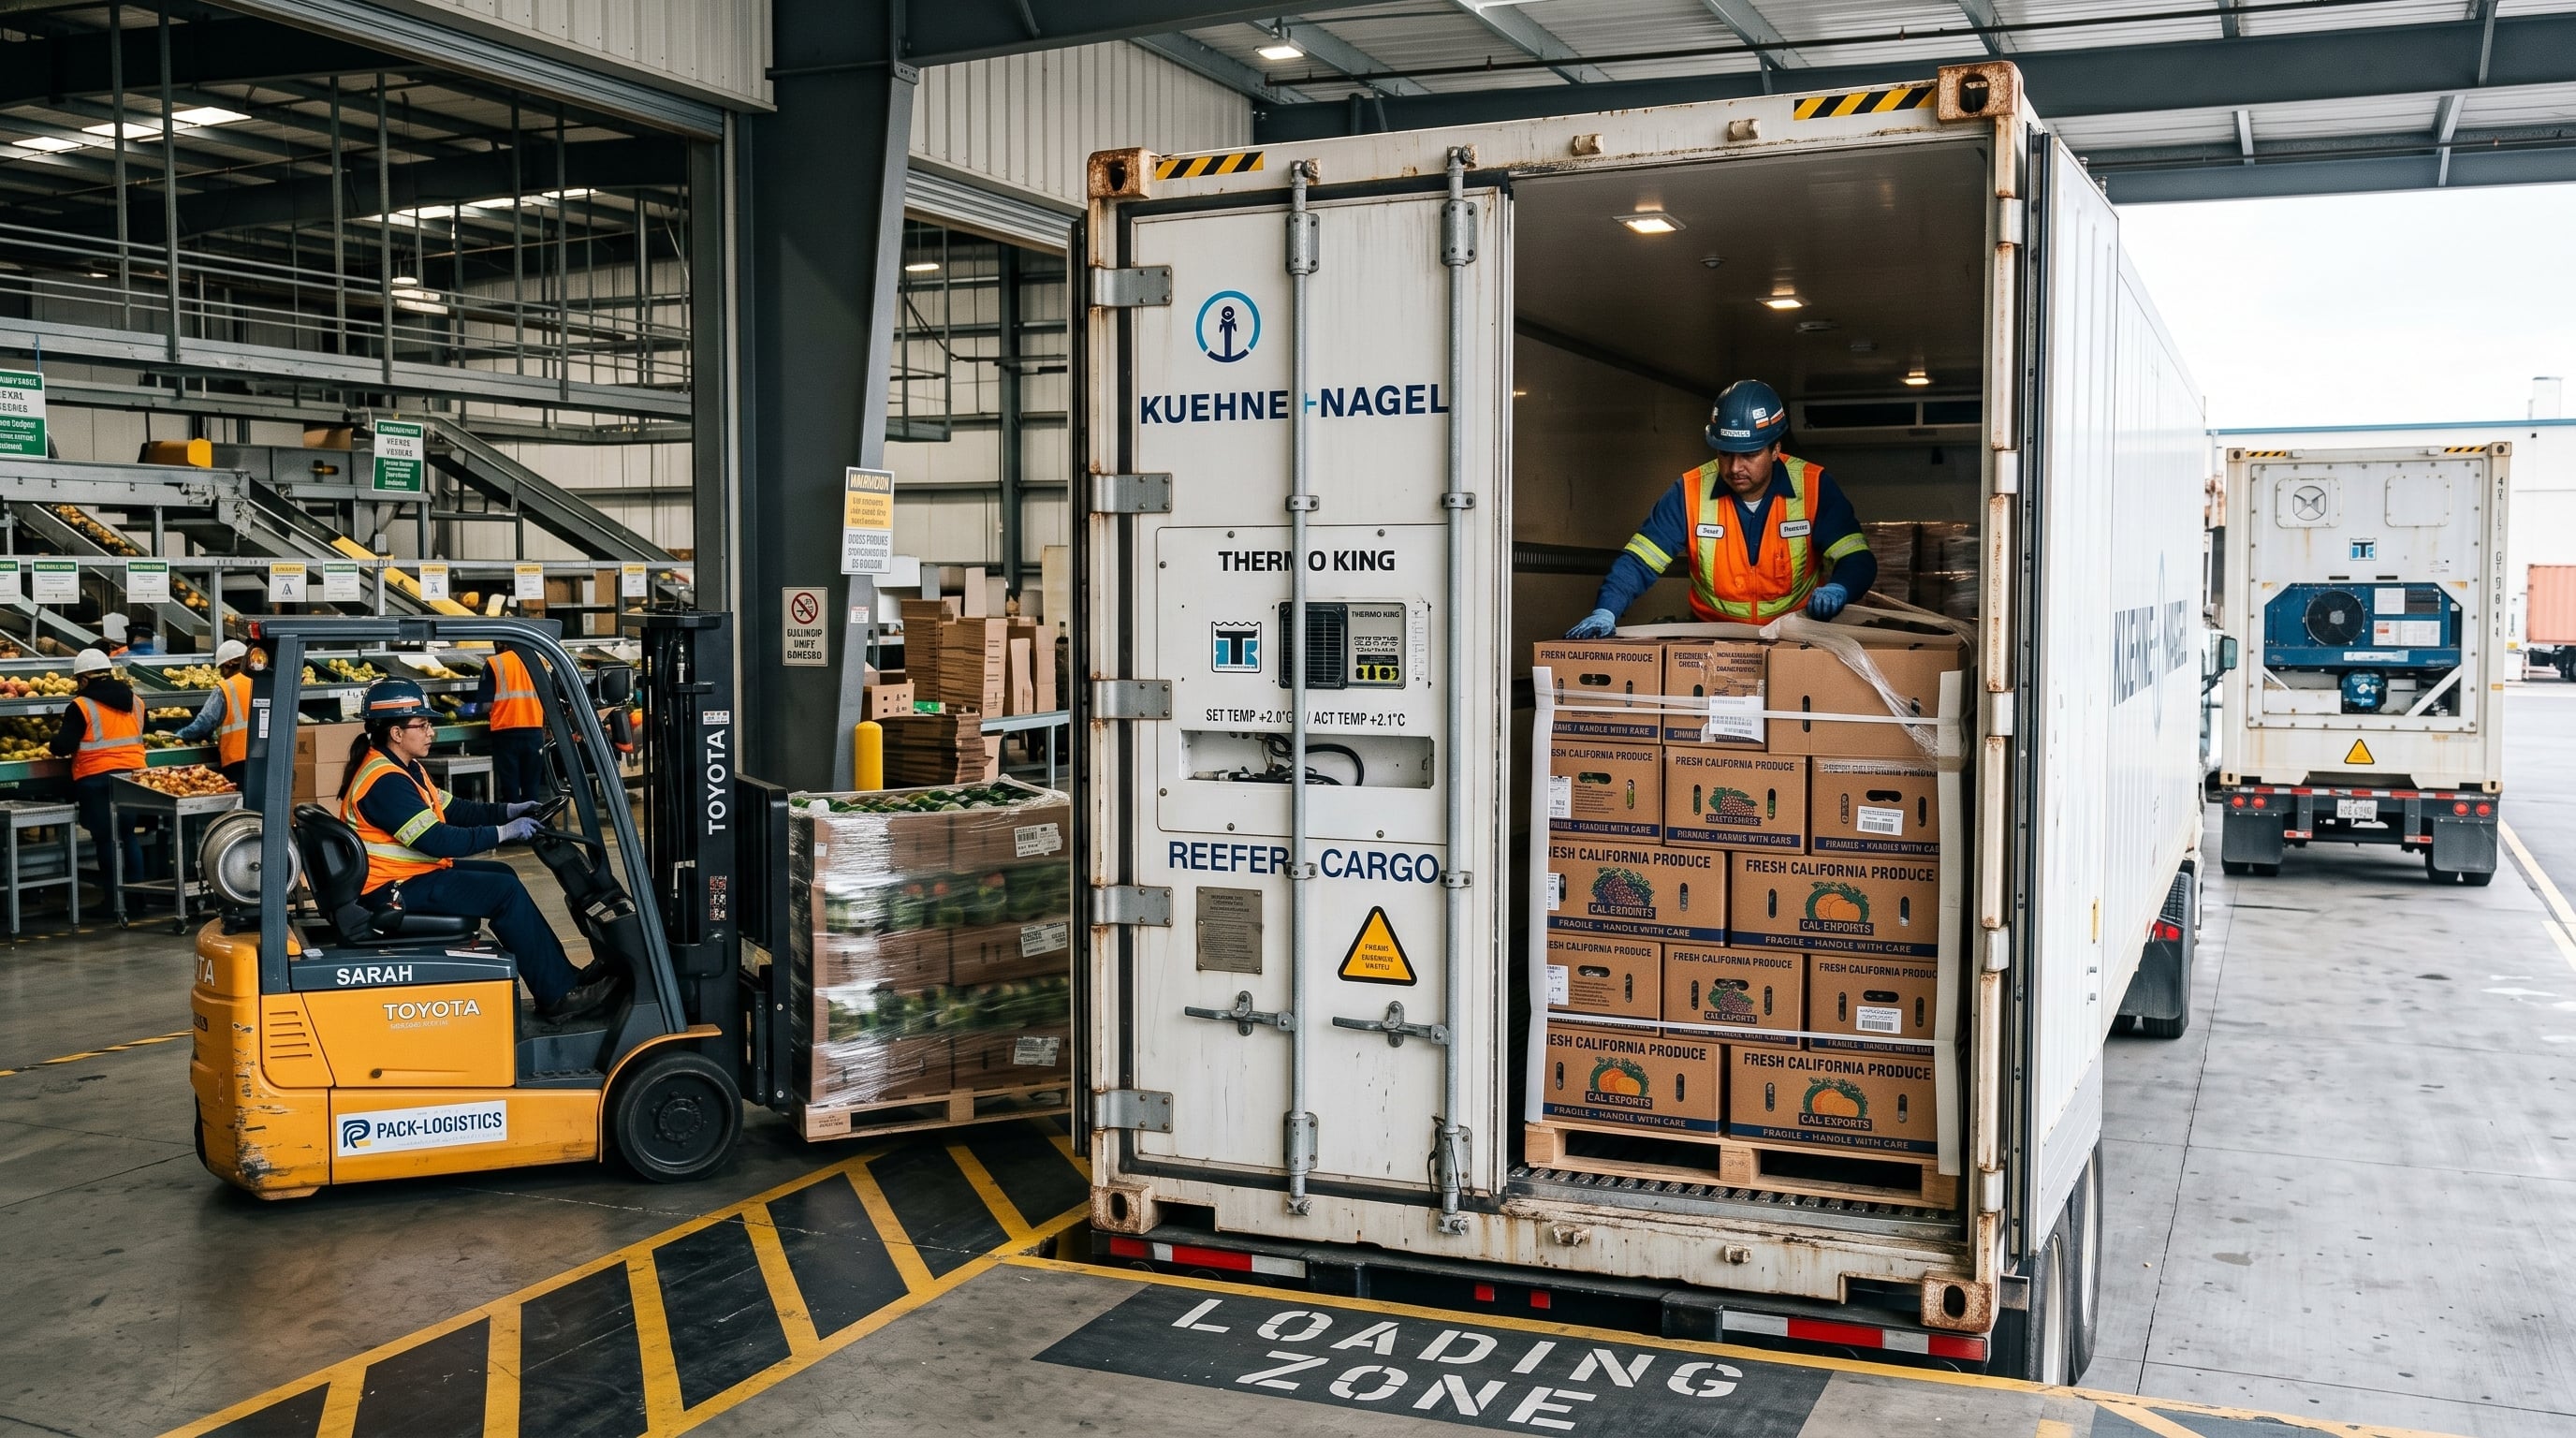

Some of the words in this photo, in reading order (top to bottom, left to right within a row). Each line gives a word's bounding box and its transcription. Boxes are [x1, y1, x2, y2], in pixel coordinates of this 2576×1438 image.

[1333, 550, 1395, 571] KING
[1568, 651, 1614, 661] CALIFORNIA
[1616, 653, 1653, 663] PRODUCE
[1207, 709, 1224, 721] SET
[1227, 709, 1256, 723] TEMP
[1313, 712, 1335, 725] ACT
[1338, 712, 1367, 726] TEMP
[1569, 749, 1613, 759] CALIFORNIA
[1617, 752, 1653, 761] PRODUCE
[1705, 758, 1752, 769] CALIFORNIA
[1756, 761, 1794, 770] PRODUCE
[707, 729, 725, 835] TOYOTA
[1169, 841, 1289, 874] REEFER
[1321, 848, 1440, 884] CARGO
[1548, 848, 1575, 858] ESH
[1579, 848, 1649, 864] CALIFORNIA
[1653, 853, 1711, 869] PRODUCE
[1746, 859, 1787, 874] FRESH
[1791, 861, 1867, 878] CALIFORNIA
[1871, 866, 1935, 882] PRODUCE
[1603, 923, 1638, 933] HANDLE
[1666, 927, 1690, 937] CARE
[1547, 940, 1564, 950] ESH
[1566, 942, 1612, 954] CALIFORNIA
[1614, 946, 1652, 957] PRODUCE
[1765, 936, 1804, 946] FRAGILE
[1815, 939, 1854, 949] HANDLE
[1885, 943, 1911, 953] CARE
[1702, 954, 1751, 966] CALIFORNIA
[336, 964, 413, 986] SARAH
[1820, 962, 1847, 974] FRESH
[1849, 964, 1900, 977] CALIFORNIA
[1902, 968, 1938, 979] PRODUC
[383, 999, 481, 1020] TOYOTA
[1547, 1034, 1573, 1047] ESH
[1576, 1036, 1646, 1054] CALIFORNIA
[1649, 1044, 1706, 1060] PRODUCE
[1744, 1052, 1785, 1068] FRESH
[1788, 1057, 1865, 1075] CALIFORNIA
[1868, 1063, 1932, 1080] PRODUCE
[1588, 1093, 1606, 1102] CAL
[377, 1111, 503, 1138] PACK-LOGISTICS
[1599, 1111, 1634, 1122] HANDLE
[1662, 1118, 1686, 1127] CARE
[1801, 1114, 1822, 1124] CAL
[1824, 1116, 1870, 1129] EXPORTS
[1883, 1139, 1909, 1150] CARE
[1171, 1299, 1744, 1398] LOADING
[1237, 1350, 1597, 1431] ZONE
